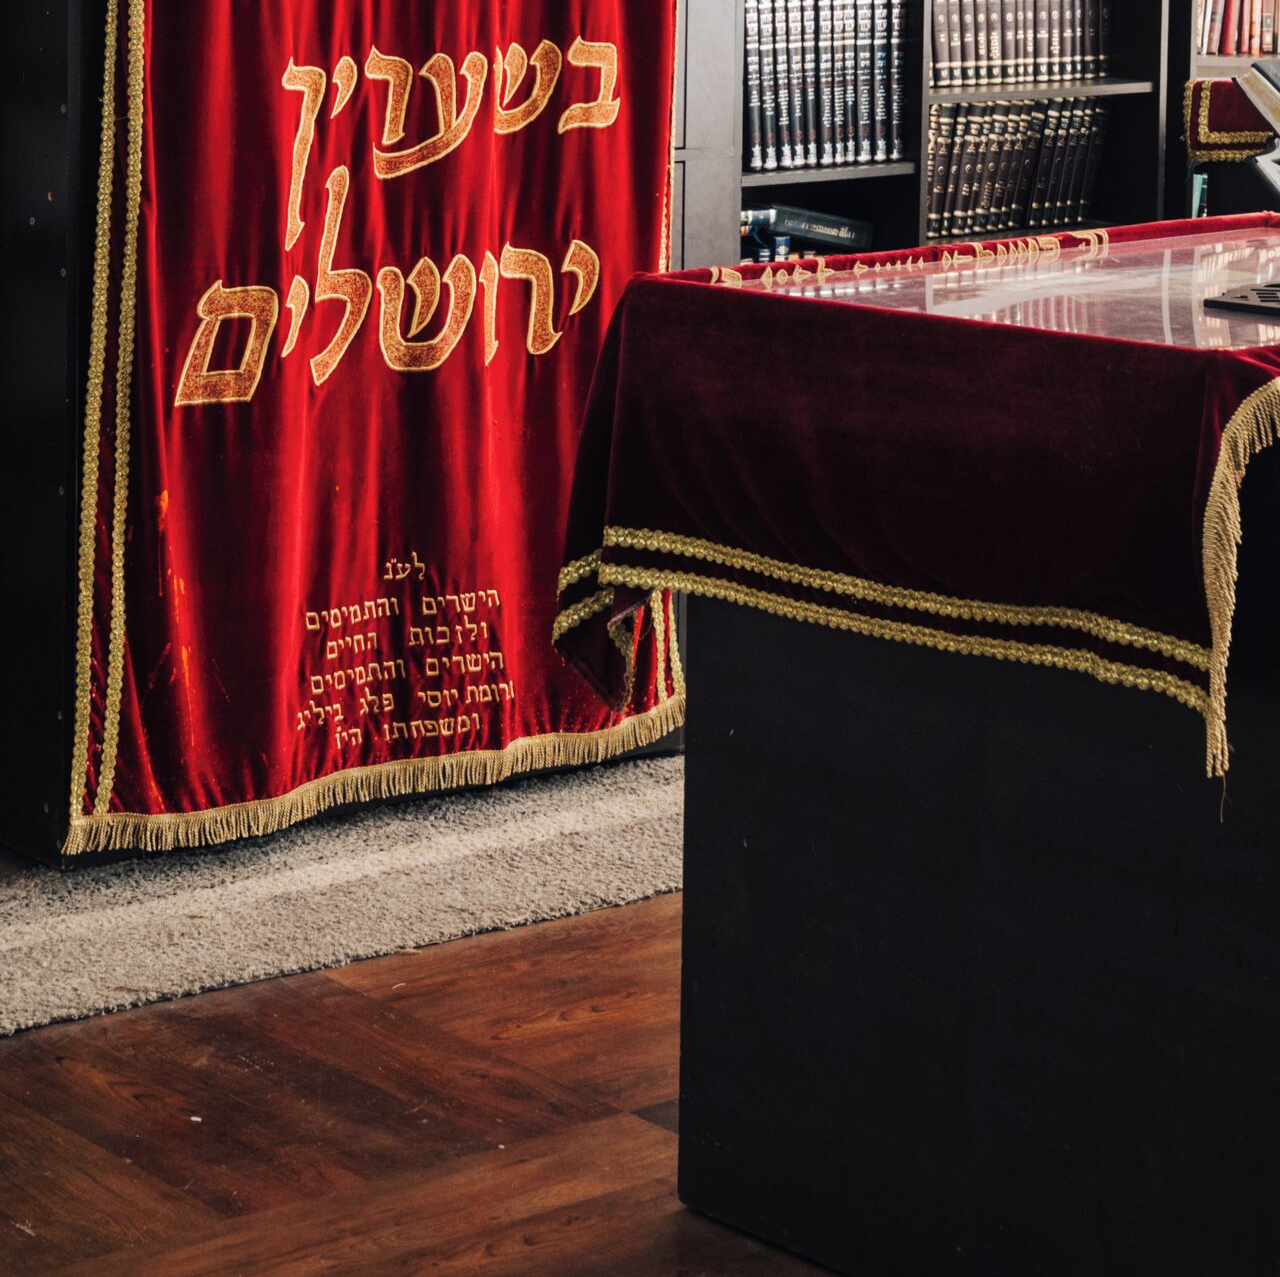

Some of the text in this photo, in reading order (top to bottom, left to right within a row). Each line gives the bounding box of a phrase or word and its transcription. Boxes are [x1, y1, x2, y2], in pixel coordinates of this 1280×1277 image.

[281, 34, 621, 253] בשעריך
[173, 164, 600, 407] ירושלים
[305, 589, 501, 631] הישרים והתמימים
[326, 615, 488, 660] ולזכות החיים
[310, 651, 504, 695] הישרים והתמימים
[360, 687, 394, 716] פלג
[417, 689, 458, 708] יוסי
[384, 713, 480, 741] ומשפחתו
